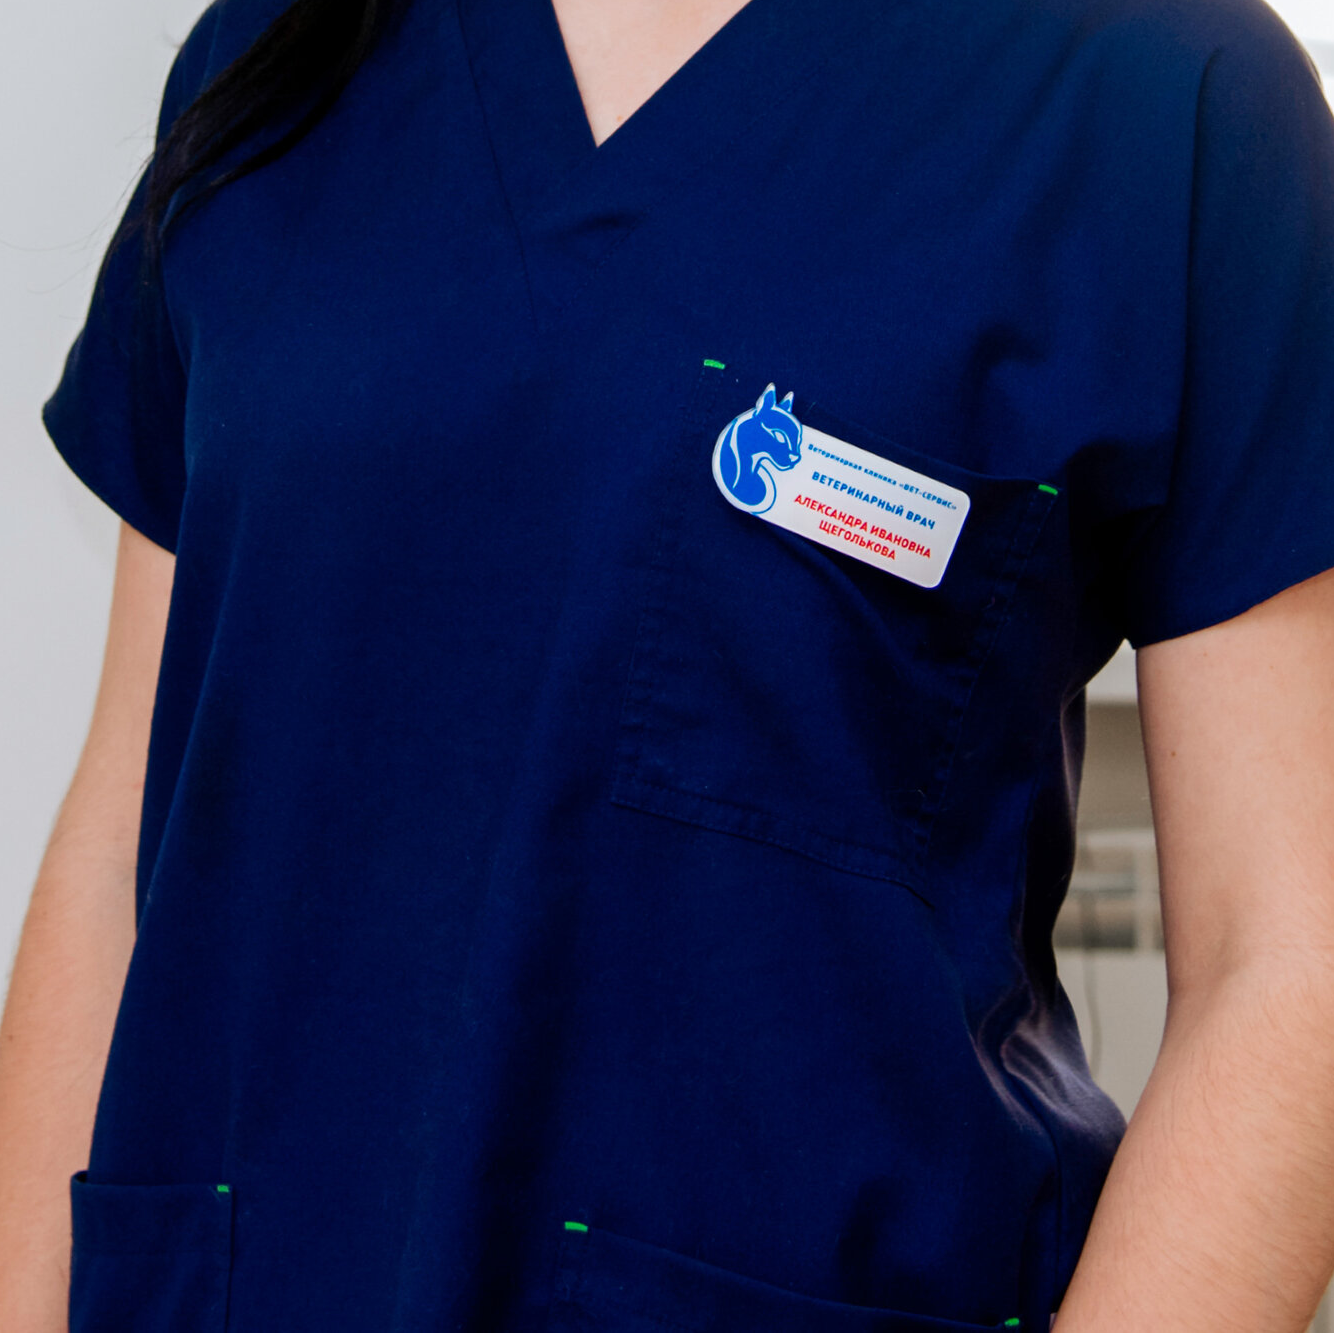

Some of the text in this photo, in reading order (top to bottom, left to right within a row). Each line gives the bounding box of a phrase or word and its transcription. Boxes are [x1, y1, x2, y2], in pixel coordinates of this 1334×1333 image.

[794, 494, 931, 559] АЛЕКСАНДРА ИВАНОВНА
[811, 471, 936, 530] ВЕТЕРИНАРНЫЙ ВРАЧ
[819, 520, 896, 560] ЩЕГОЛЬКОВА
